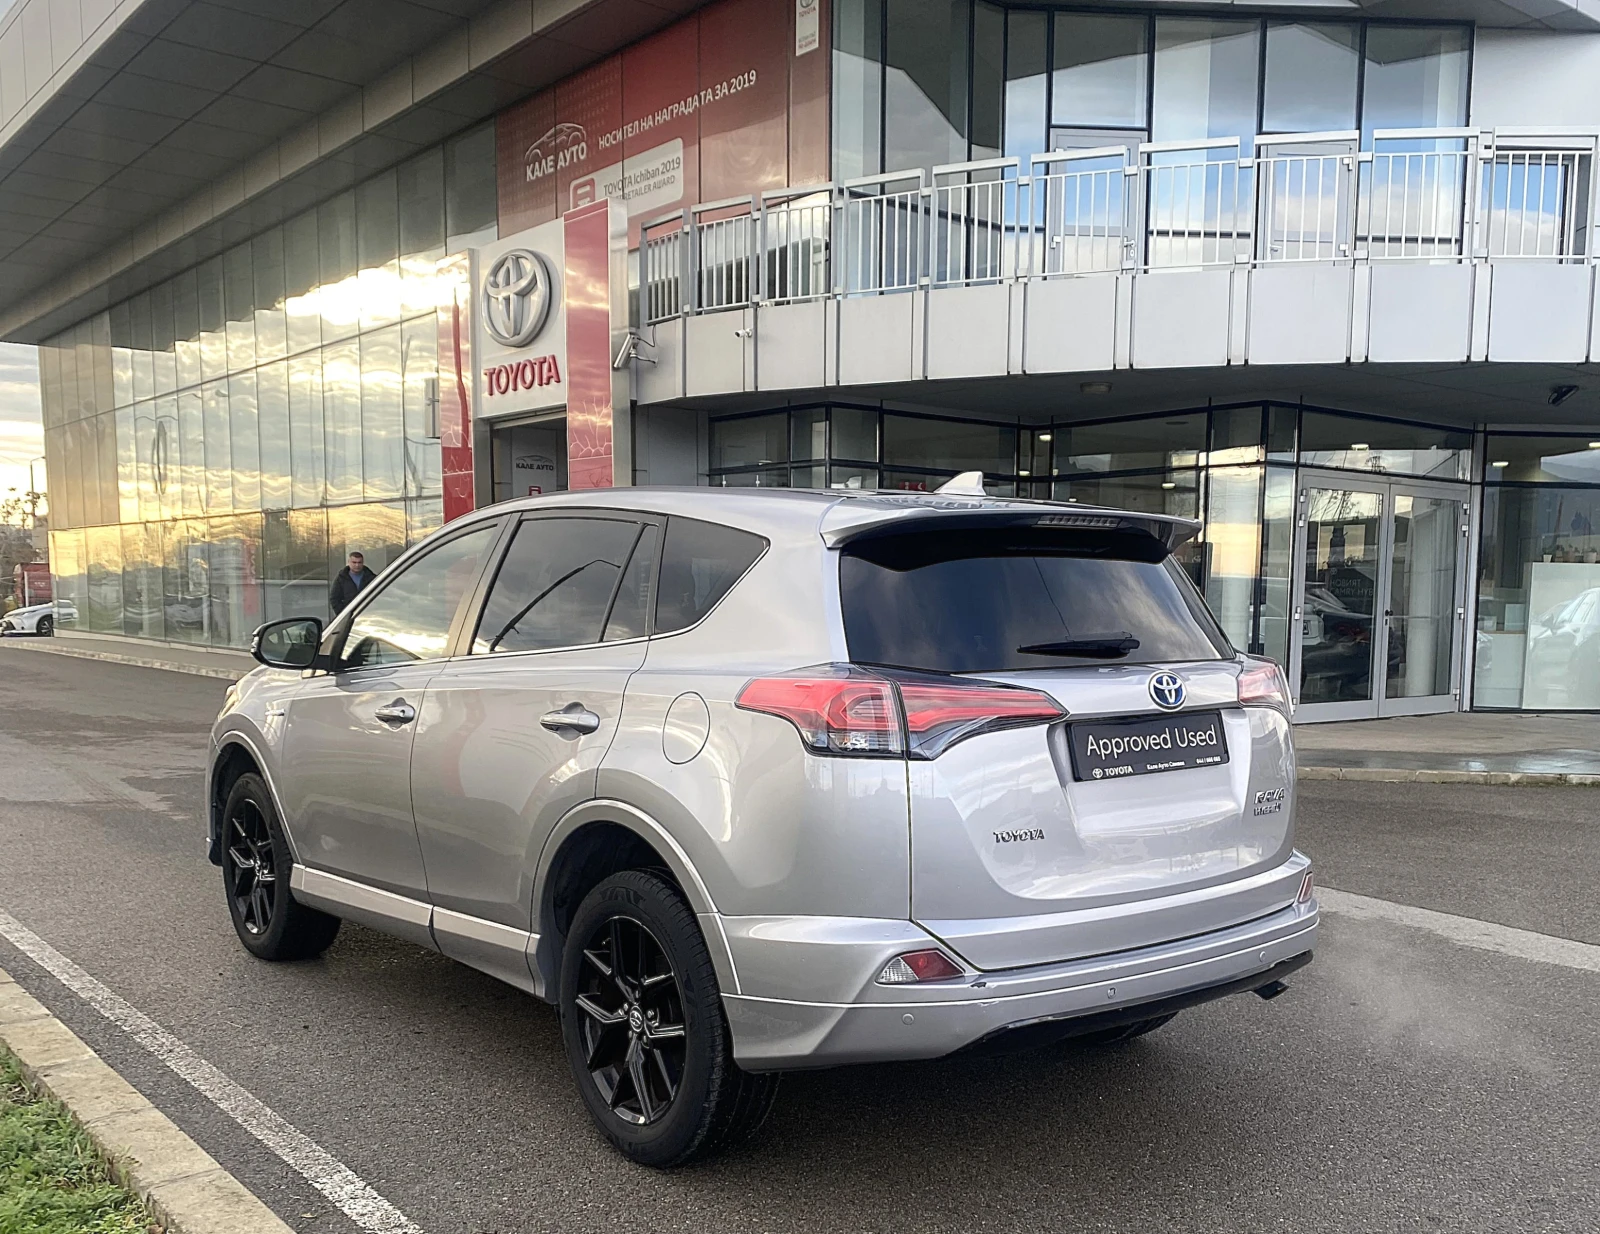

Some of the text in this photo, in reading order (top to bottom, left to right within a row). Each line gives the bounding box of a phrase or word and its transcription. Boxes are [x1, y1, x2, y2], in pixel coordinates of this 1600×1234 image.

[598, 119, 639, 149] НОСИТЕЛ
[640, 114, 653, 131] НА
[714, 81, 728, 100] ЗА
[729, 69, 757, 93] 2019
[526, 141, 587, 182] КАЛЕ АУТО
[603, 156, 681, 196] TOYOTA Ichiban 2019
[652, 174, 676, 191] AWARD
[483, 354, 561, 397] TOYOTA
[515, 462, 535, 470] КАЛЕ
[1086, 724, 1218, 760] Approved Used
[1104, 765, 1134, 777] TOYOTA
[992, 828, 1045, 843] TOYOTA
